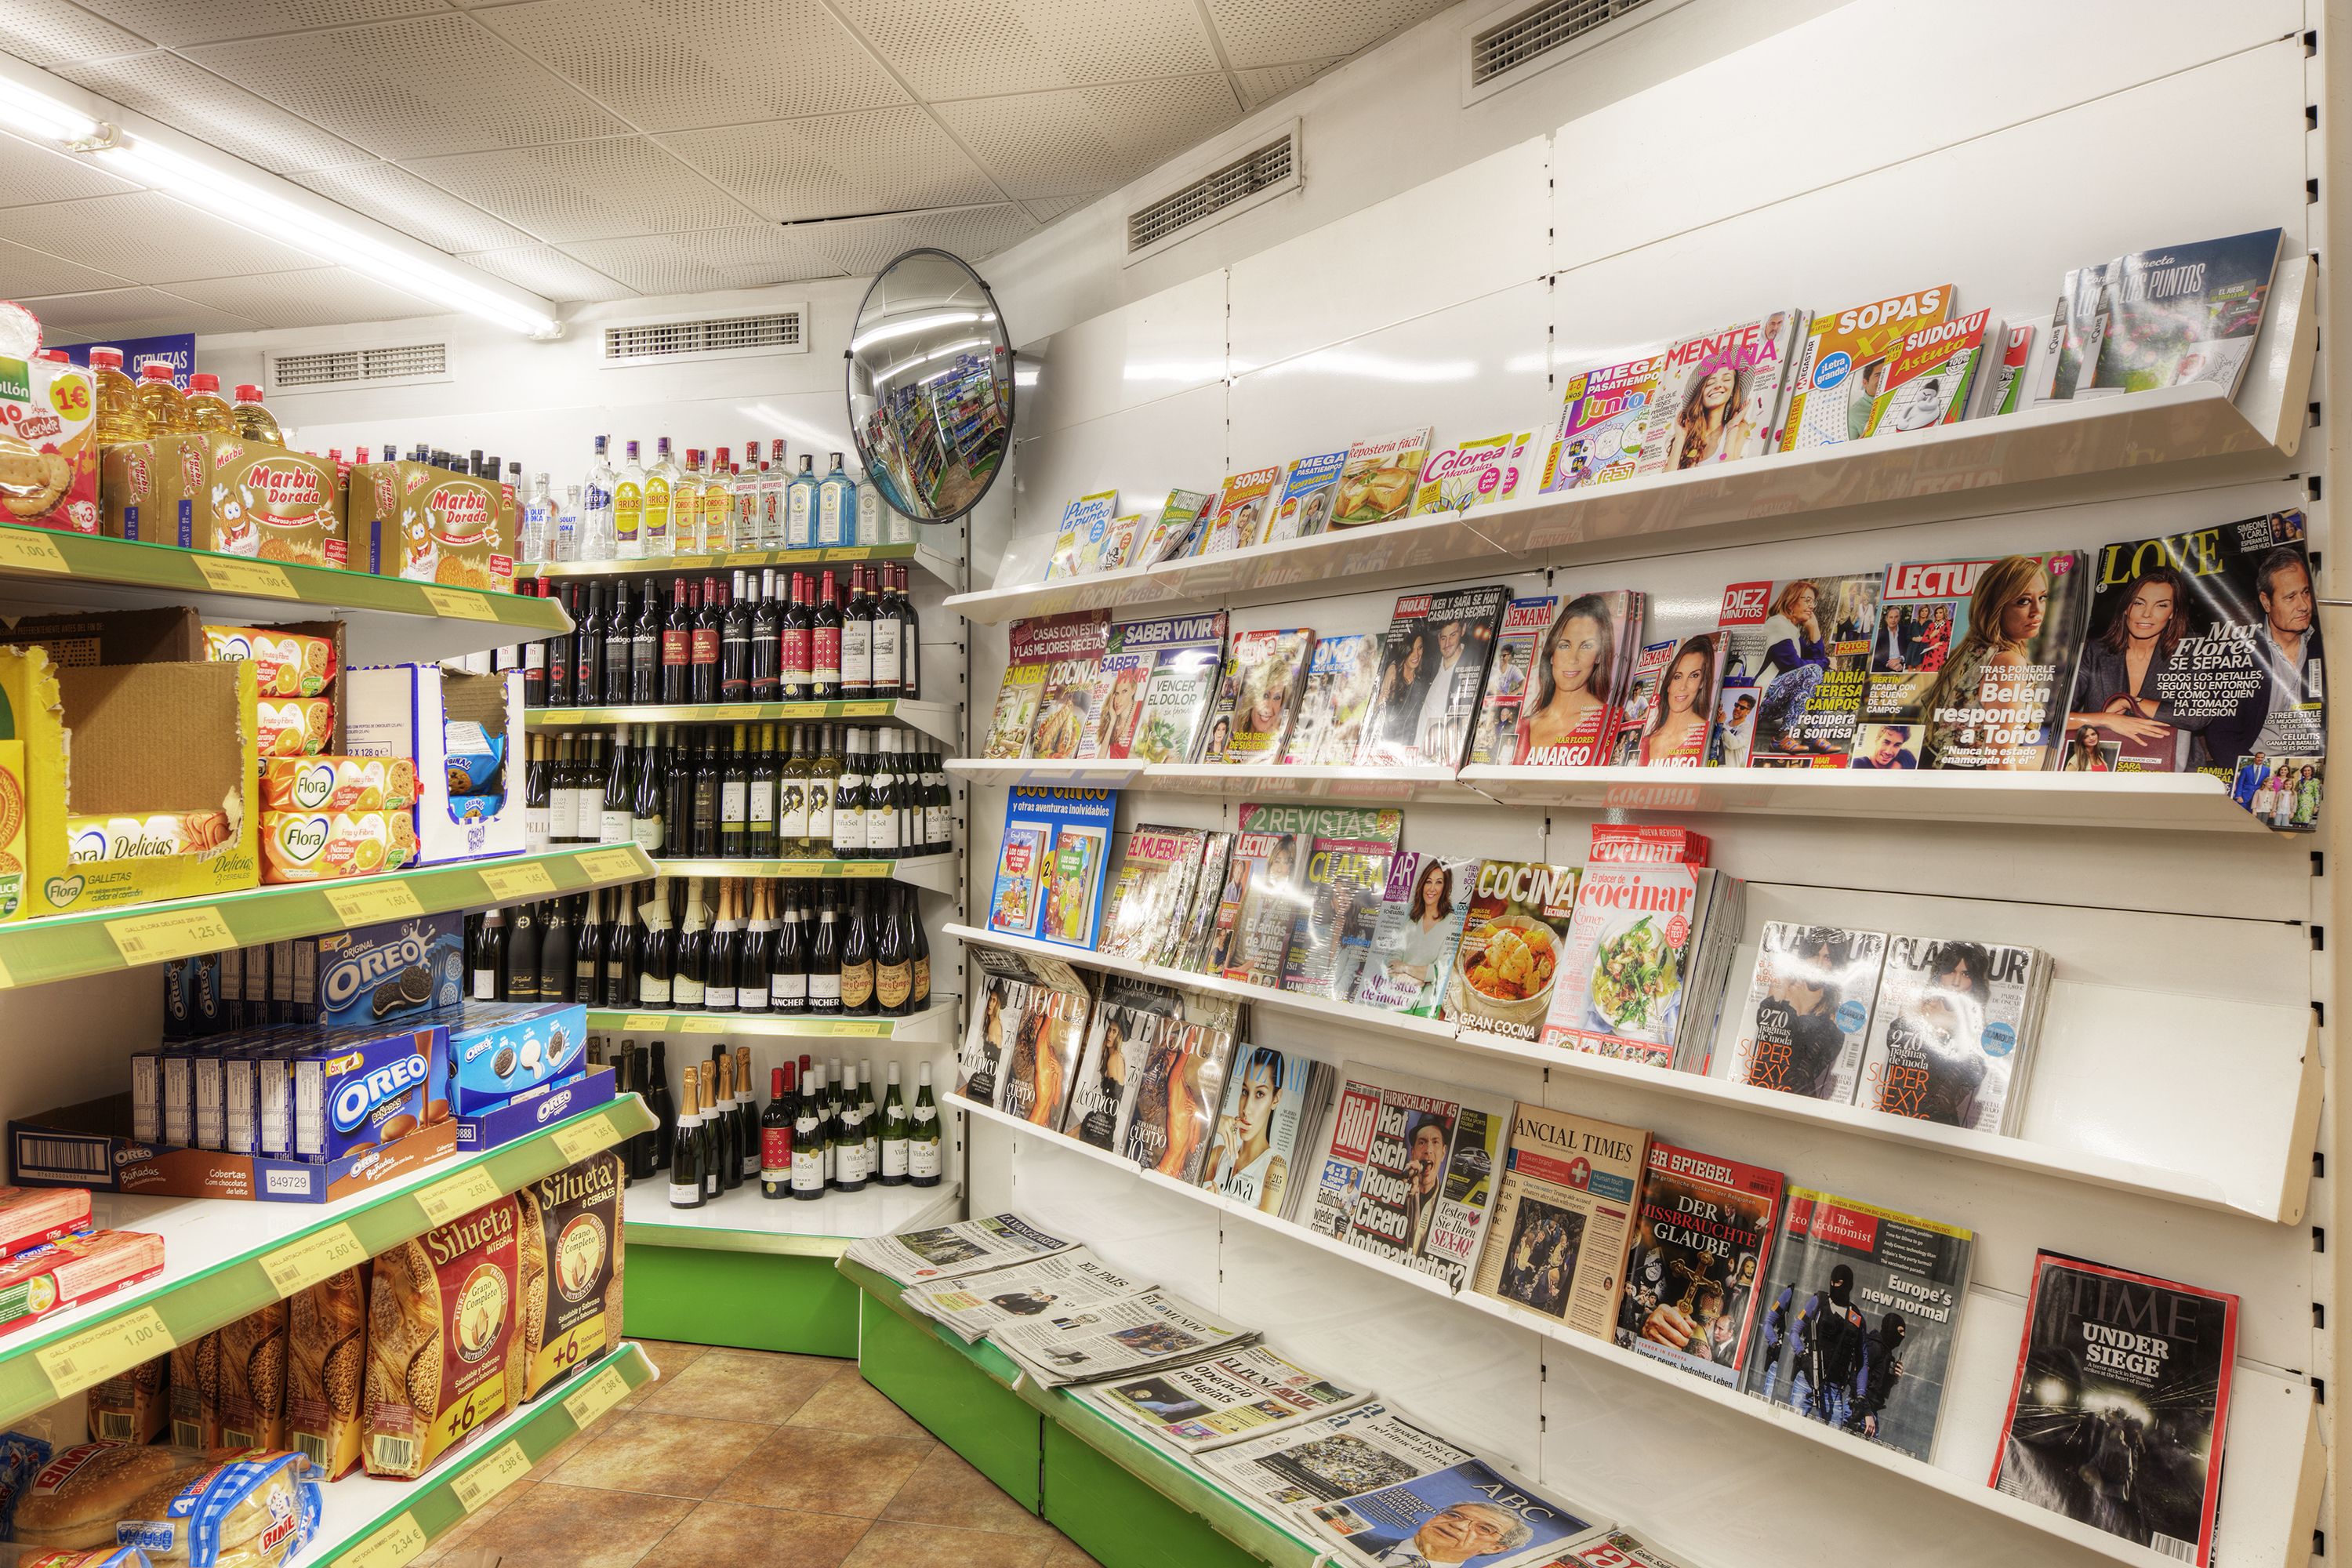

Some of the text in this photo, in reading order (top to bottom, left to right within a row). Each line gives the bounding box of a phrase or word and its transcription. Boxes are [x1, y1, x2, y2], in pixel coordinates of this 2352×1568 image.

[2129, 256, 2176, 270] Conecta
[2119, 263, 2206, 304] LOS PUNTOS
[1838, 289, 1941, 335] SOPAS
[1905, 312, 1984, 352] SUDOKU
[1664, 325, 1761, 372] MENTE
[1698, 339, 1777, 376] SANA
[1895, 336, 1969, 377] Astuto
[1588, 358, 1664, 385] MEGA
[1821, 357, 1845, 374] ¡Letra
[1947, 354, 1972, 370] 100%
[1817, 365, 1848, 385] grande!
[55, 385, 89, 410] 1€
[1576, 388, 1657, 427] Junior
[20, 416, 59, 438] Chocolate
[1348, 435, 1421, 459] Repostería fácil
[248, 464, 318, 489] Marbú
[1424, 447, 1506, 483] Colorea
[1444, 462, 1493, 479] Mandalas
[762, 481, 782, 490] BEEFEATER
[1233, 469, 1275, 490] SOPAS
[268, 489, 320, 503] Dorada
[431, 489, 487, 511] Marbú
[1223, 484, 1269, 506] Semanal
[446, 510, 488, 524] Dorada
[1068, 500, 1103, 519] Punto
[1074, 508, 1110, 529] punto
[16, 544, 58, 558] 1,00 €
[2103, 528, 2224, 585] LOVE
[1396, 597, 1432, 618] ¡HOLA!
[1725, 588, 1767, 610] DIEZ
[1505, 601, 1552, 627] SEMANA
[1722, 608, 1763, 619] MINUTOS
[1033, 627, 1058, 641] CASAS
[1059, 626, 1078, 639] CON
[1124, 618, 1212, 644] SABER VIVIR
[2205, 620, 2263, 642] Mar
[2171, 639, 2257, 658] Flores
[1004, 664, 1048, 685] EL MUEBLE
[1049, 659, 1098, 686] COCINA
[1100, 655, 1139, 673] SABER
[1156, 680, 1196, 692] VENCER
[1823, 670, 1865, 684] MARÍA
[1148, 693, 1197, 706] EL DOLOR
[1806, 698, 1860, 711] CAMPOS
[1980, 683, 2051, 702] Belén
[1933, 706, 2046, 727] responde
[1788, 726, 1853, 739] la sonrisa
[1525, 746, 1591, 765] AMARGO
[297, 778, 326, 793] Flora
[1018, 801, 1035, 811] otras
[1036, 803, 1068, 814] aventuras
[1069, 804, 1110, 817] inolvidables
[1253, 808, 1377, 838] 2 REVISTAS
[114, 834, 172, 858] Delicias
[287, 829, 321, 846] Flora
[330, 844, 354, 853] Naranja
[213, 855, 253, 873] Delicias
[88, 873, 132, 884] GALLETAS
[1478, 864, 1576, 909] COCINA
[50, 886, 78, 898] Flora
[387, 895, 405, 908] 1,60
[1579, 875, 1693, 913] cocinar
[188, 924, 226, 939] 1,25 €
[343, 940, 374, 958] ORIGINAL
[328, 941, 419, 1001] OREO
[1738, 1038, 1793, 1065] SUPER
[1234, 1045, 1308, 1094] BAZAAR
[336, 1057, 426, 1125] OREO
[1076, 1081, 1119, 1116] Icónico
[1872, 1084, 1926, 1112] SEXY
[537, 1091, 572, 1122] OREO
[1385, 1091, 1458, 1118] HIRNSCHLAG MIT 45
[593, 1127, 608, 1139] 1,85
[1334, 1094, 1378, 1152] Bild
[1377, 1105, 1410, 1138] Hat
[1130, 1125, 1167, 1150] cuerpo
[1582, 1133, 1634, 1163] TIMES
[114, 1148, 153, 1164] OREO
[120, 1167, 159, 1182] Bañadas
[209, 1169, 247, 1179] Cobertas
[1671, 1154, 1735, 1185] SPIEGEL
[270, 1177, 307, 1188] 849729
[542, 1163, 613, 1211] Silueta
[1362, 1170, 1411, 1206] Roger
[583, 1188, 615, 1209] 8 CEREALES
[1676, 1195, 1718, 1222] DER
[1355, 1196, 1409, 1240] Cicero
[1441, 1201, 1468, 1221] Testen
[427, 1207, 514, 1266] Silueta
[571, 1229, 590, 1241] Grano
[1010, 1218, 1067, 1250] VANGUARDIA
[1653, 1222, 1732, 1259] GLAUBE
[1816, 1218, 1872, 1243] Economist
[326, 1240, 358, 1261] 2,60 €
[486, 1234, 514, 1255] INTEGRAL
[565, 1235, 596, 1254] Completo
[1431, 1228, 1474, 1259] SEX-IQ!
[1077, 1261, 1129, 1289] EL PAÍS
[1887, 1273, 1953, 1307] Europe's
[1140, 1294, 1206, 1333] EL MUNDO
[1862, 1287, 1950, 1324] new normal
[2062, 1271, 2203, 1345] TIME
[124, 1321, 165, 1347] 1,00 €
[581, 1327, 604, 1345] Rebanadas
[2082, 1321, 2170, 1360] UNDER
[554, 1329, 578, 1368] +6
[2085, 1343, 2161, 1379] SIEGE
[1192, 1363, 1256, 1399] Operació
[448, 1393, 475, 1437] +6
[40, 1441, 122, 1490] BIMBO
[499, 1452, 524, 1474] 2,98 €
[1472, 1481, 1556, 1523] ABC
[392, 1530, 421, 1555] 2,34 €
